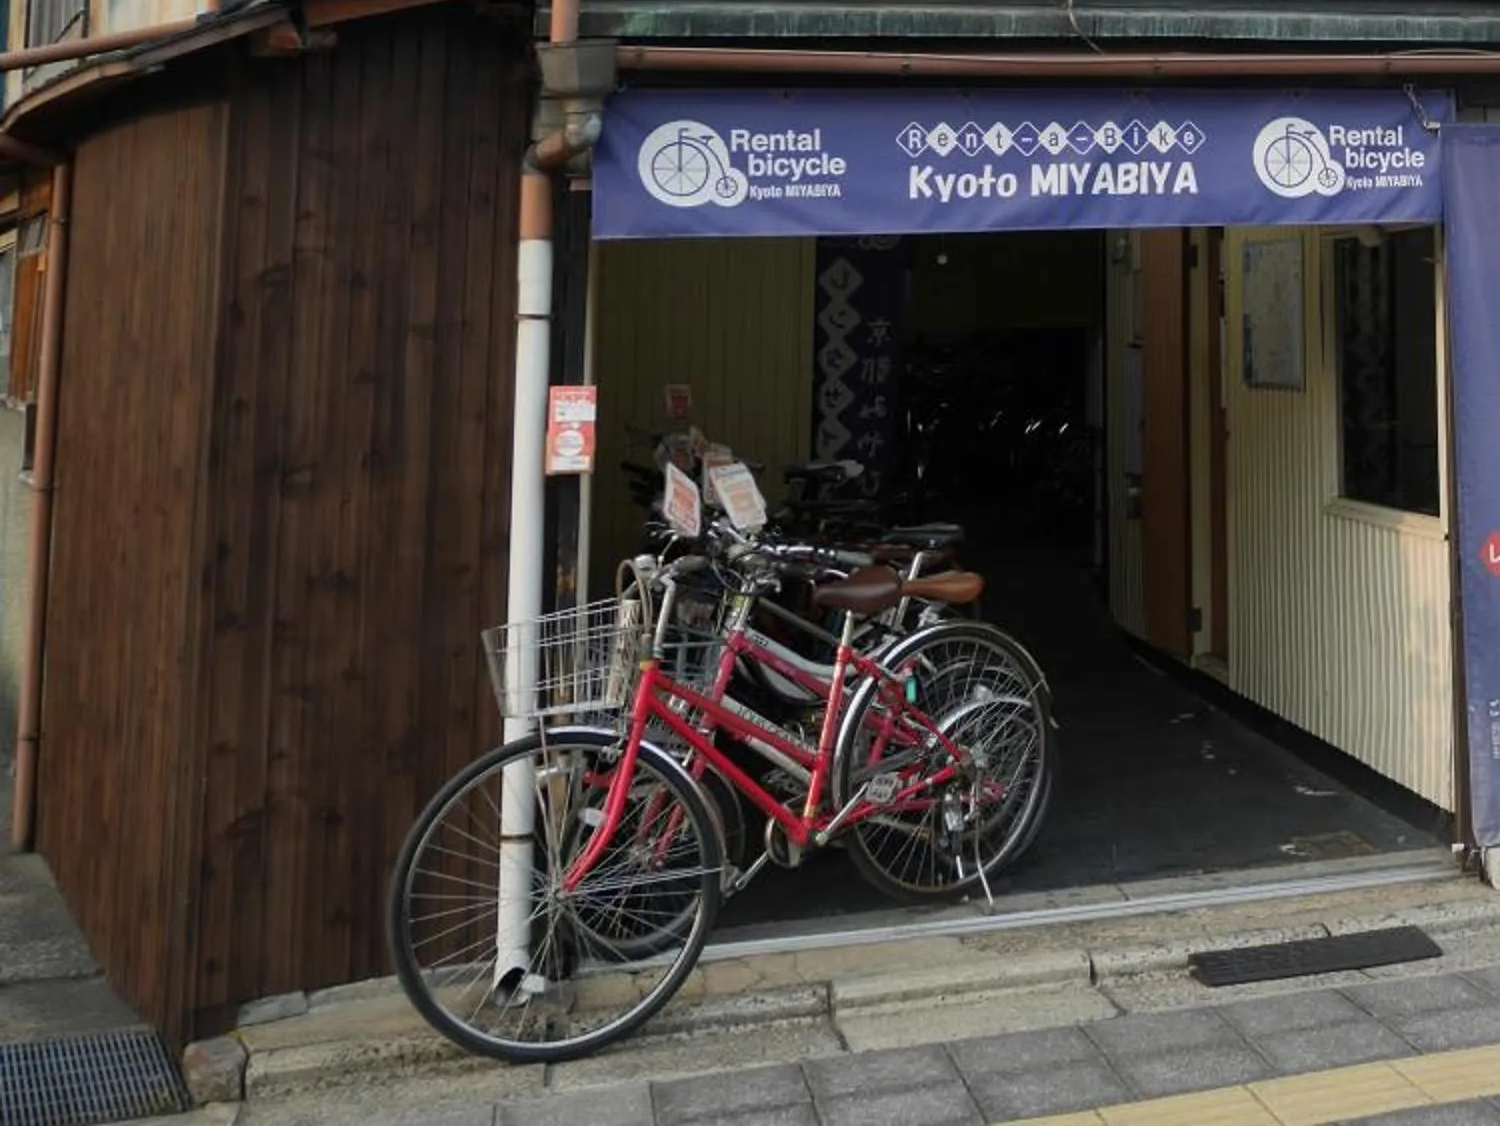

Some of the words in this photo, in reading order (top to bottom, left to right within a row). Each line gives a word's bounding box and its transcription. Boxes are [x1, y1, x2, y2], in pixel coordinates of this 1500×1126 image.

[730, 128, 821, 153] Rental
[907, 125, 1195, 150] Rent-a-Bike
[1329, 124, 1403, 147] Rental
[748, 152, 847, 181] bicycle
[1345, 147, 1425, 173] bicycle
[749, 185, 783, 201] Kyoto
[785, 183, 841, 198] MIYABIYA
[908, 164, 1018, 203] Kyoto
[1030, 161, 1199, 197] MIYABIYA
